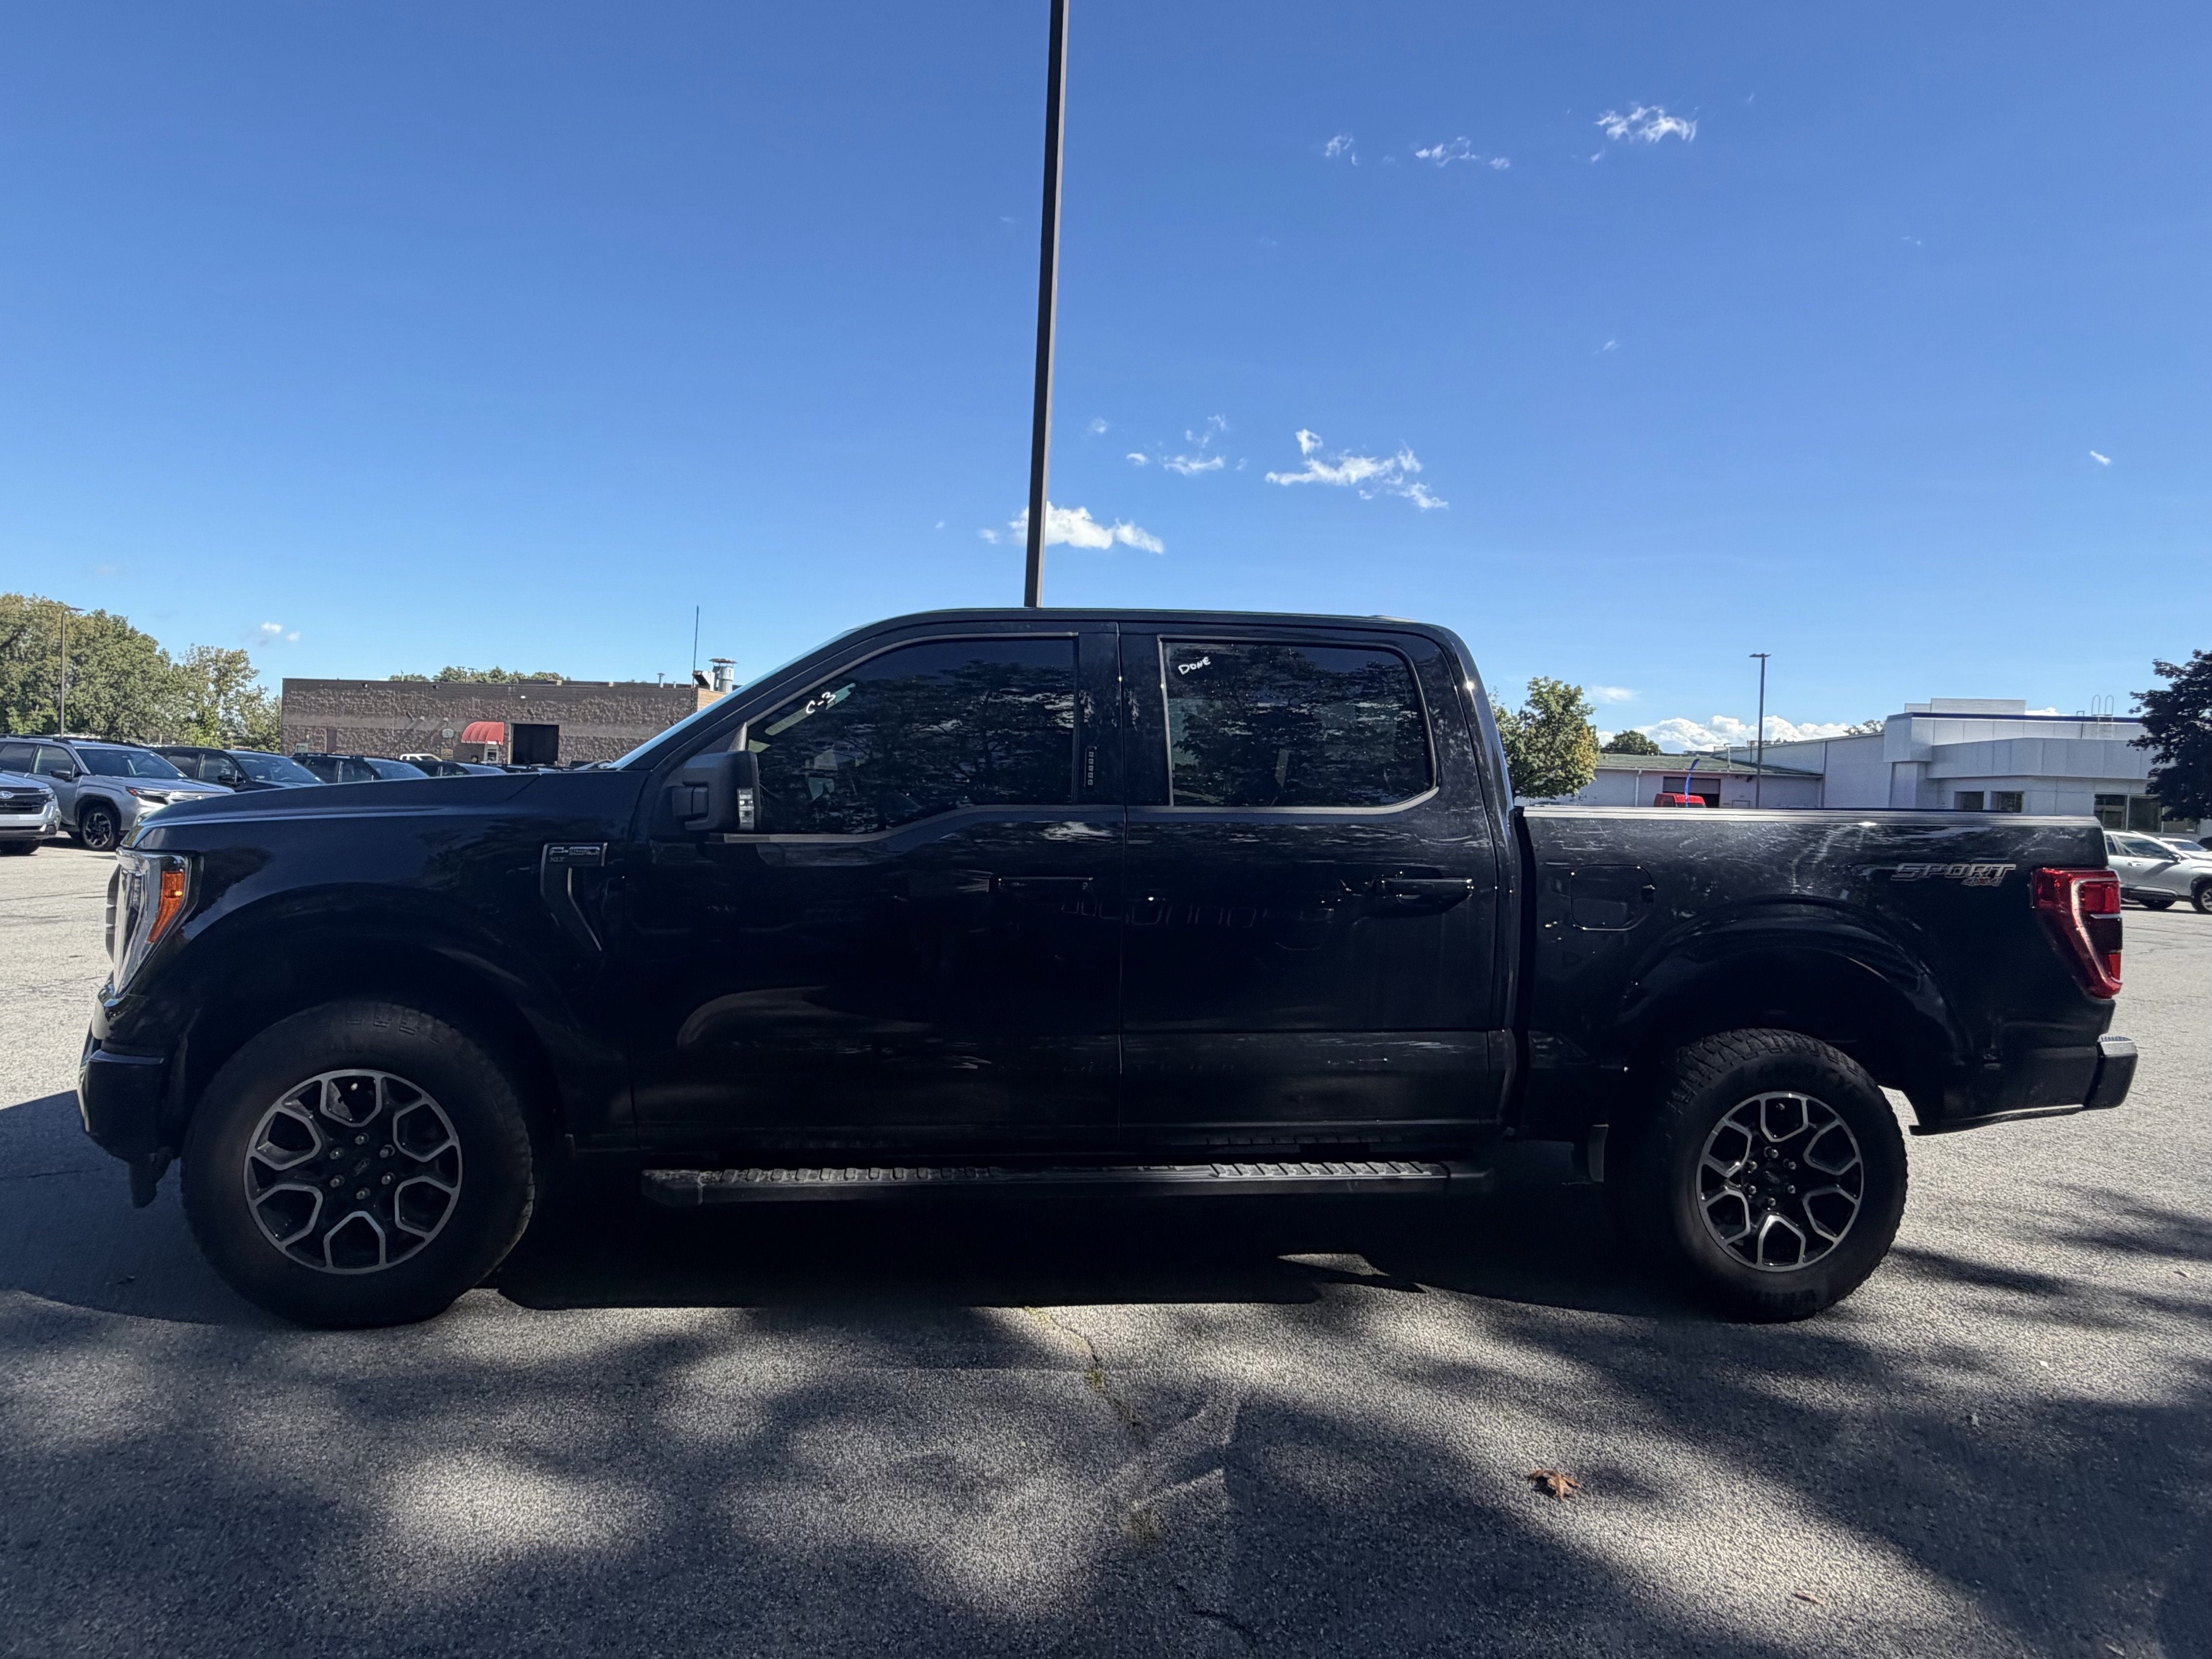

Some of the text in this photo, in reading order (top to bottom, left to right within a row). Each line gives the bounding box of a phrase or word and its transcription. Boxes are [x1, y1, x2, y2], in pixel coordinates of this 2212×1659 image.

[1178, 656, 1211, 675] DONE
[806, 691, 836, 714] C-3
[549, 846, 600, 855] F-150
[1890, 863, 2016, 882] SPORT
